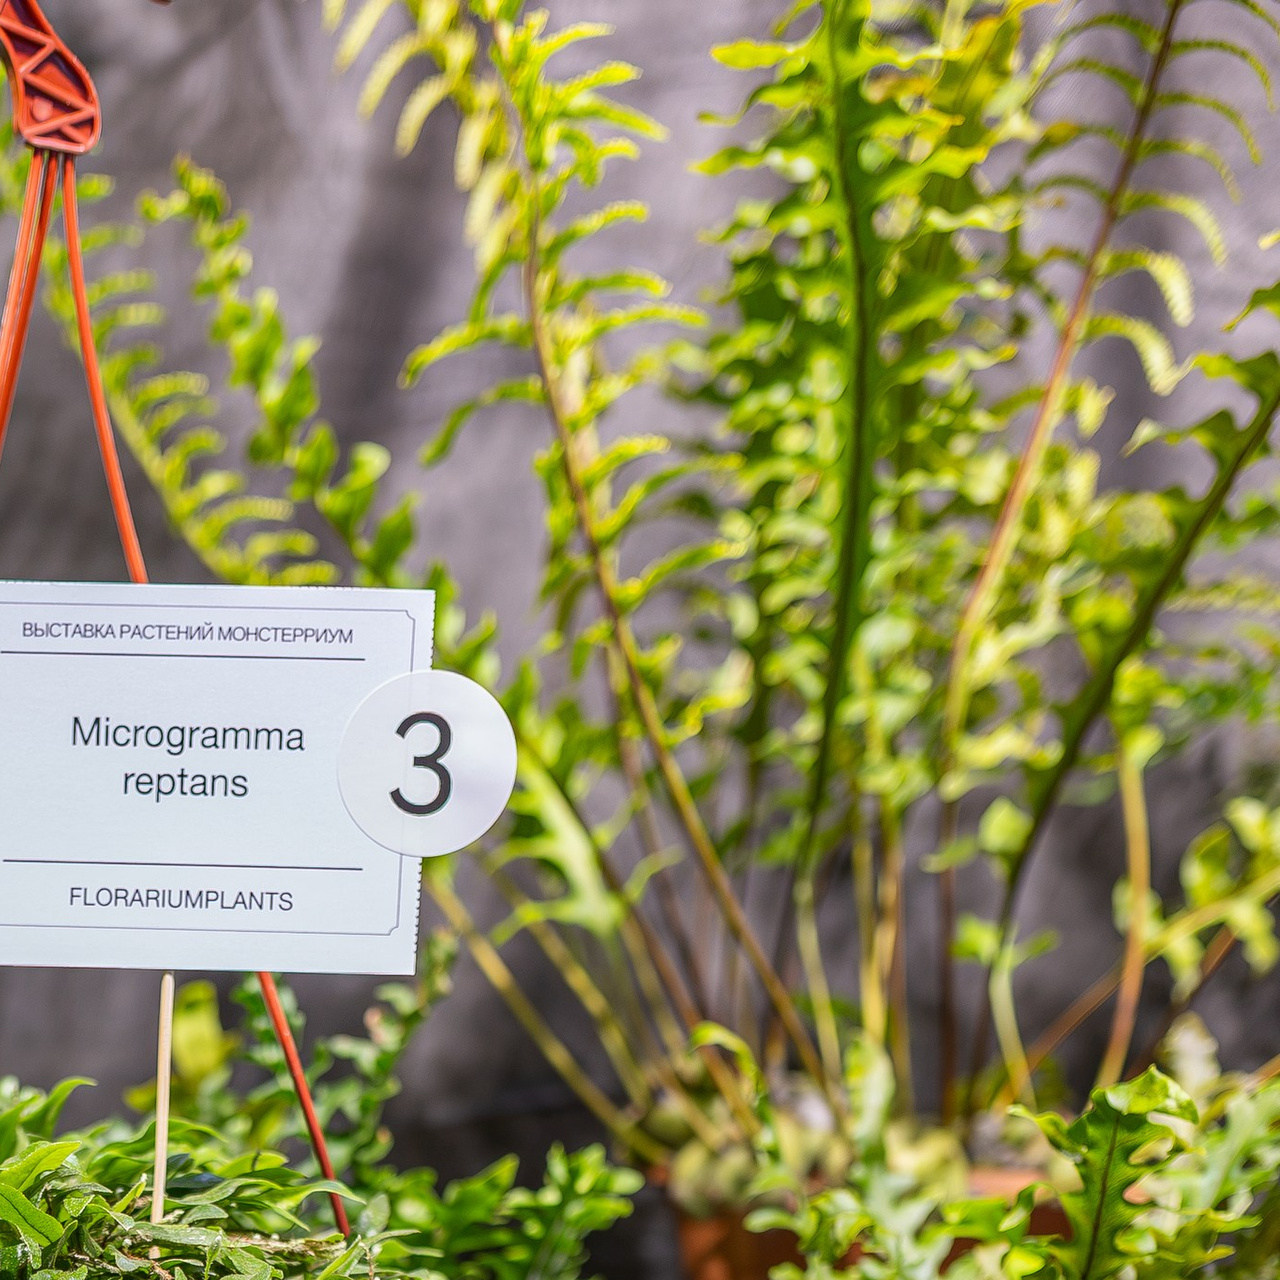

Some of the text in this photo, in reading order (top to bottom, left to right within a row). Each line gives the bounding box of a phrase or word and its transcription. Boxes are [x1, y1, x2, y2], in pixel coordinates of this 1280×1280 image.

[22, 622, 354, 644] ВЫСТАВКА РАСТЕНИЙ МОНСТЕРРИУМ
[71, 716, 306, 756] Microgramma
[389, 711, 453, 816] 3
[123, 767, 249, 803] reptans
[69, 887, 294, 912] FLORARIUMPLANTS
